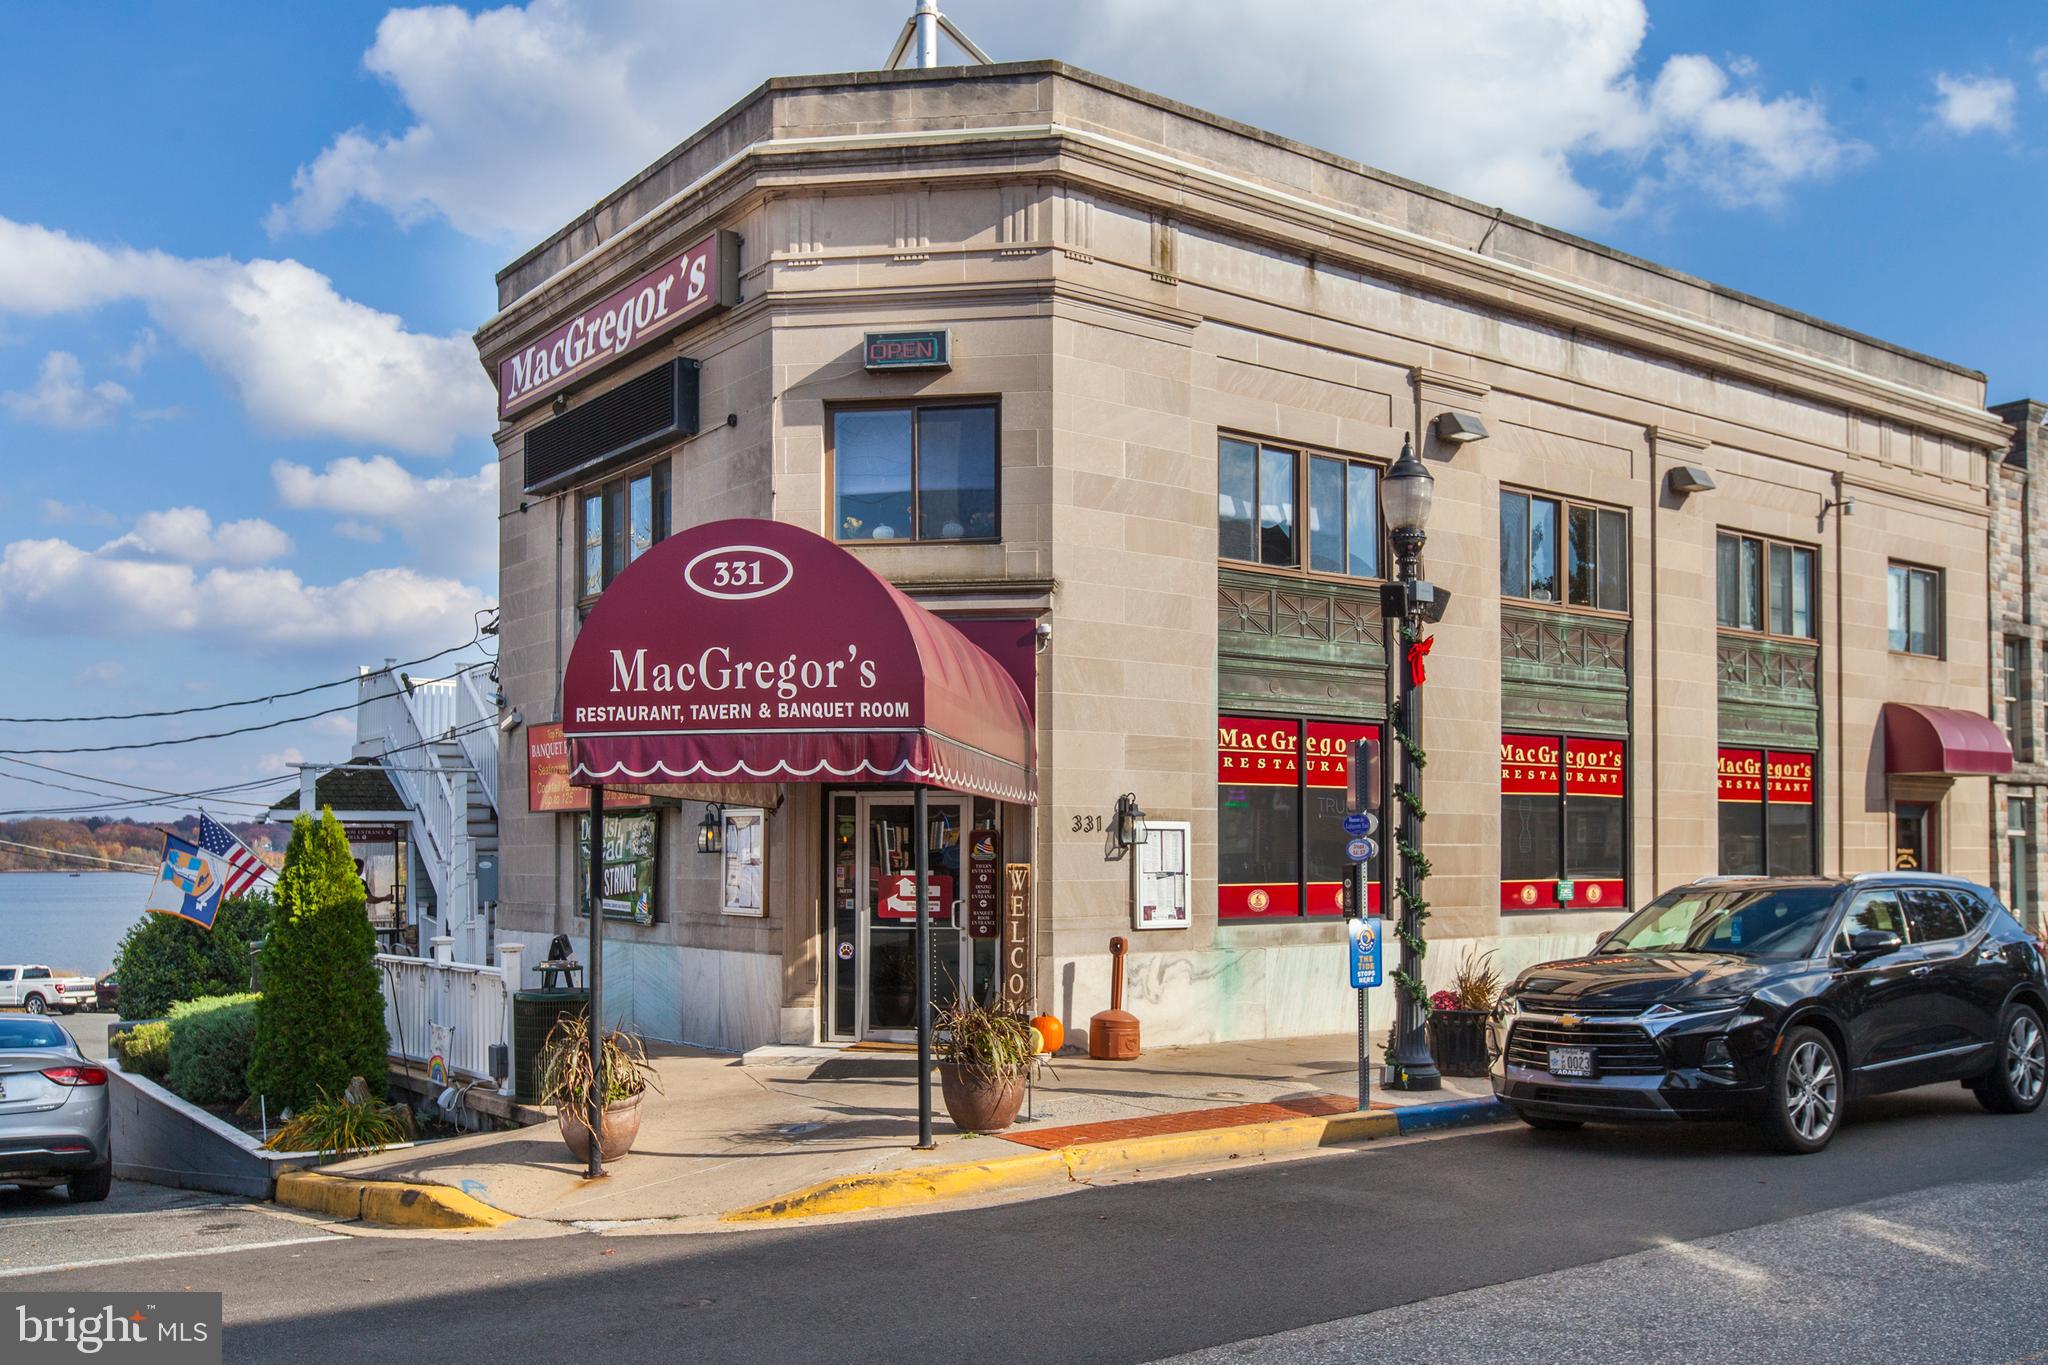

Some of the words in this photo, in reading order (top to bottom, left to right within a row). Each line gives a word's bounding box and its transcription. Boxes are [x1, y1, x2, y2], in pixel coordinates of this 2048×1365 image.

[508, 254, 707, 400] MacGregor's
[870, 341, 932, 359] OPEN
[713, 560, 764, 587] 331
[609, 644, 877, 700] MacGregor's
[576, 705, 684, 723] RESTAURANT,
[690, 703, 751, 720] TAVERN
[758, 703, 771, 718] &
[778, 702, 854, 719] BANQUET
[860, 702, 909, 718] ROOM
[531, 741, 563, 759] BANQUET
[1218, 728, 1347, 757] MacGrego
[1223, 757, 1344, 772] RESTAURA
[1500, 744, 1621, 768] MacGregor's
[1502, 769, 1617, 783] RESTAURANT
[1717, 757, 1811, 779] MacGregor's
[1717, 780, 1808, 792] RESTAURANT
[581, 817, 621, 841] Dish
[1071, 814, 1102, 833] 331
[604, 863, 637, 896] STRONG
[1358, 962, 1375, 970] TIDE
[1567, 1056, 1590, 1070] 0023
